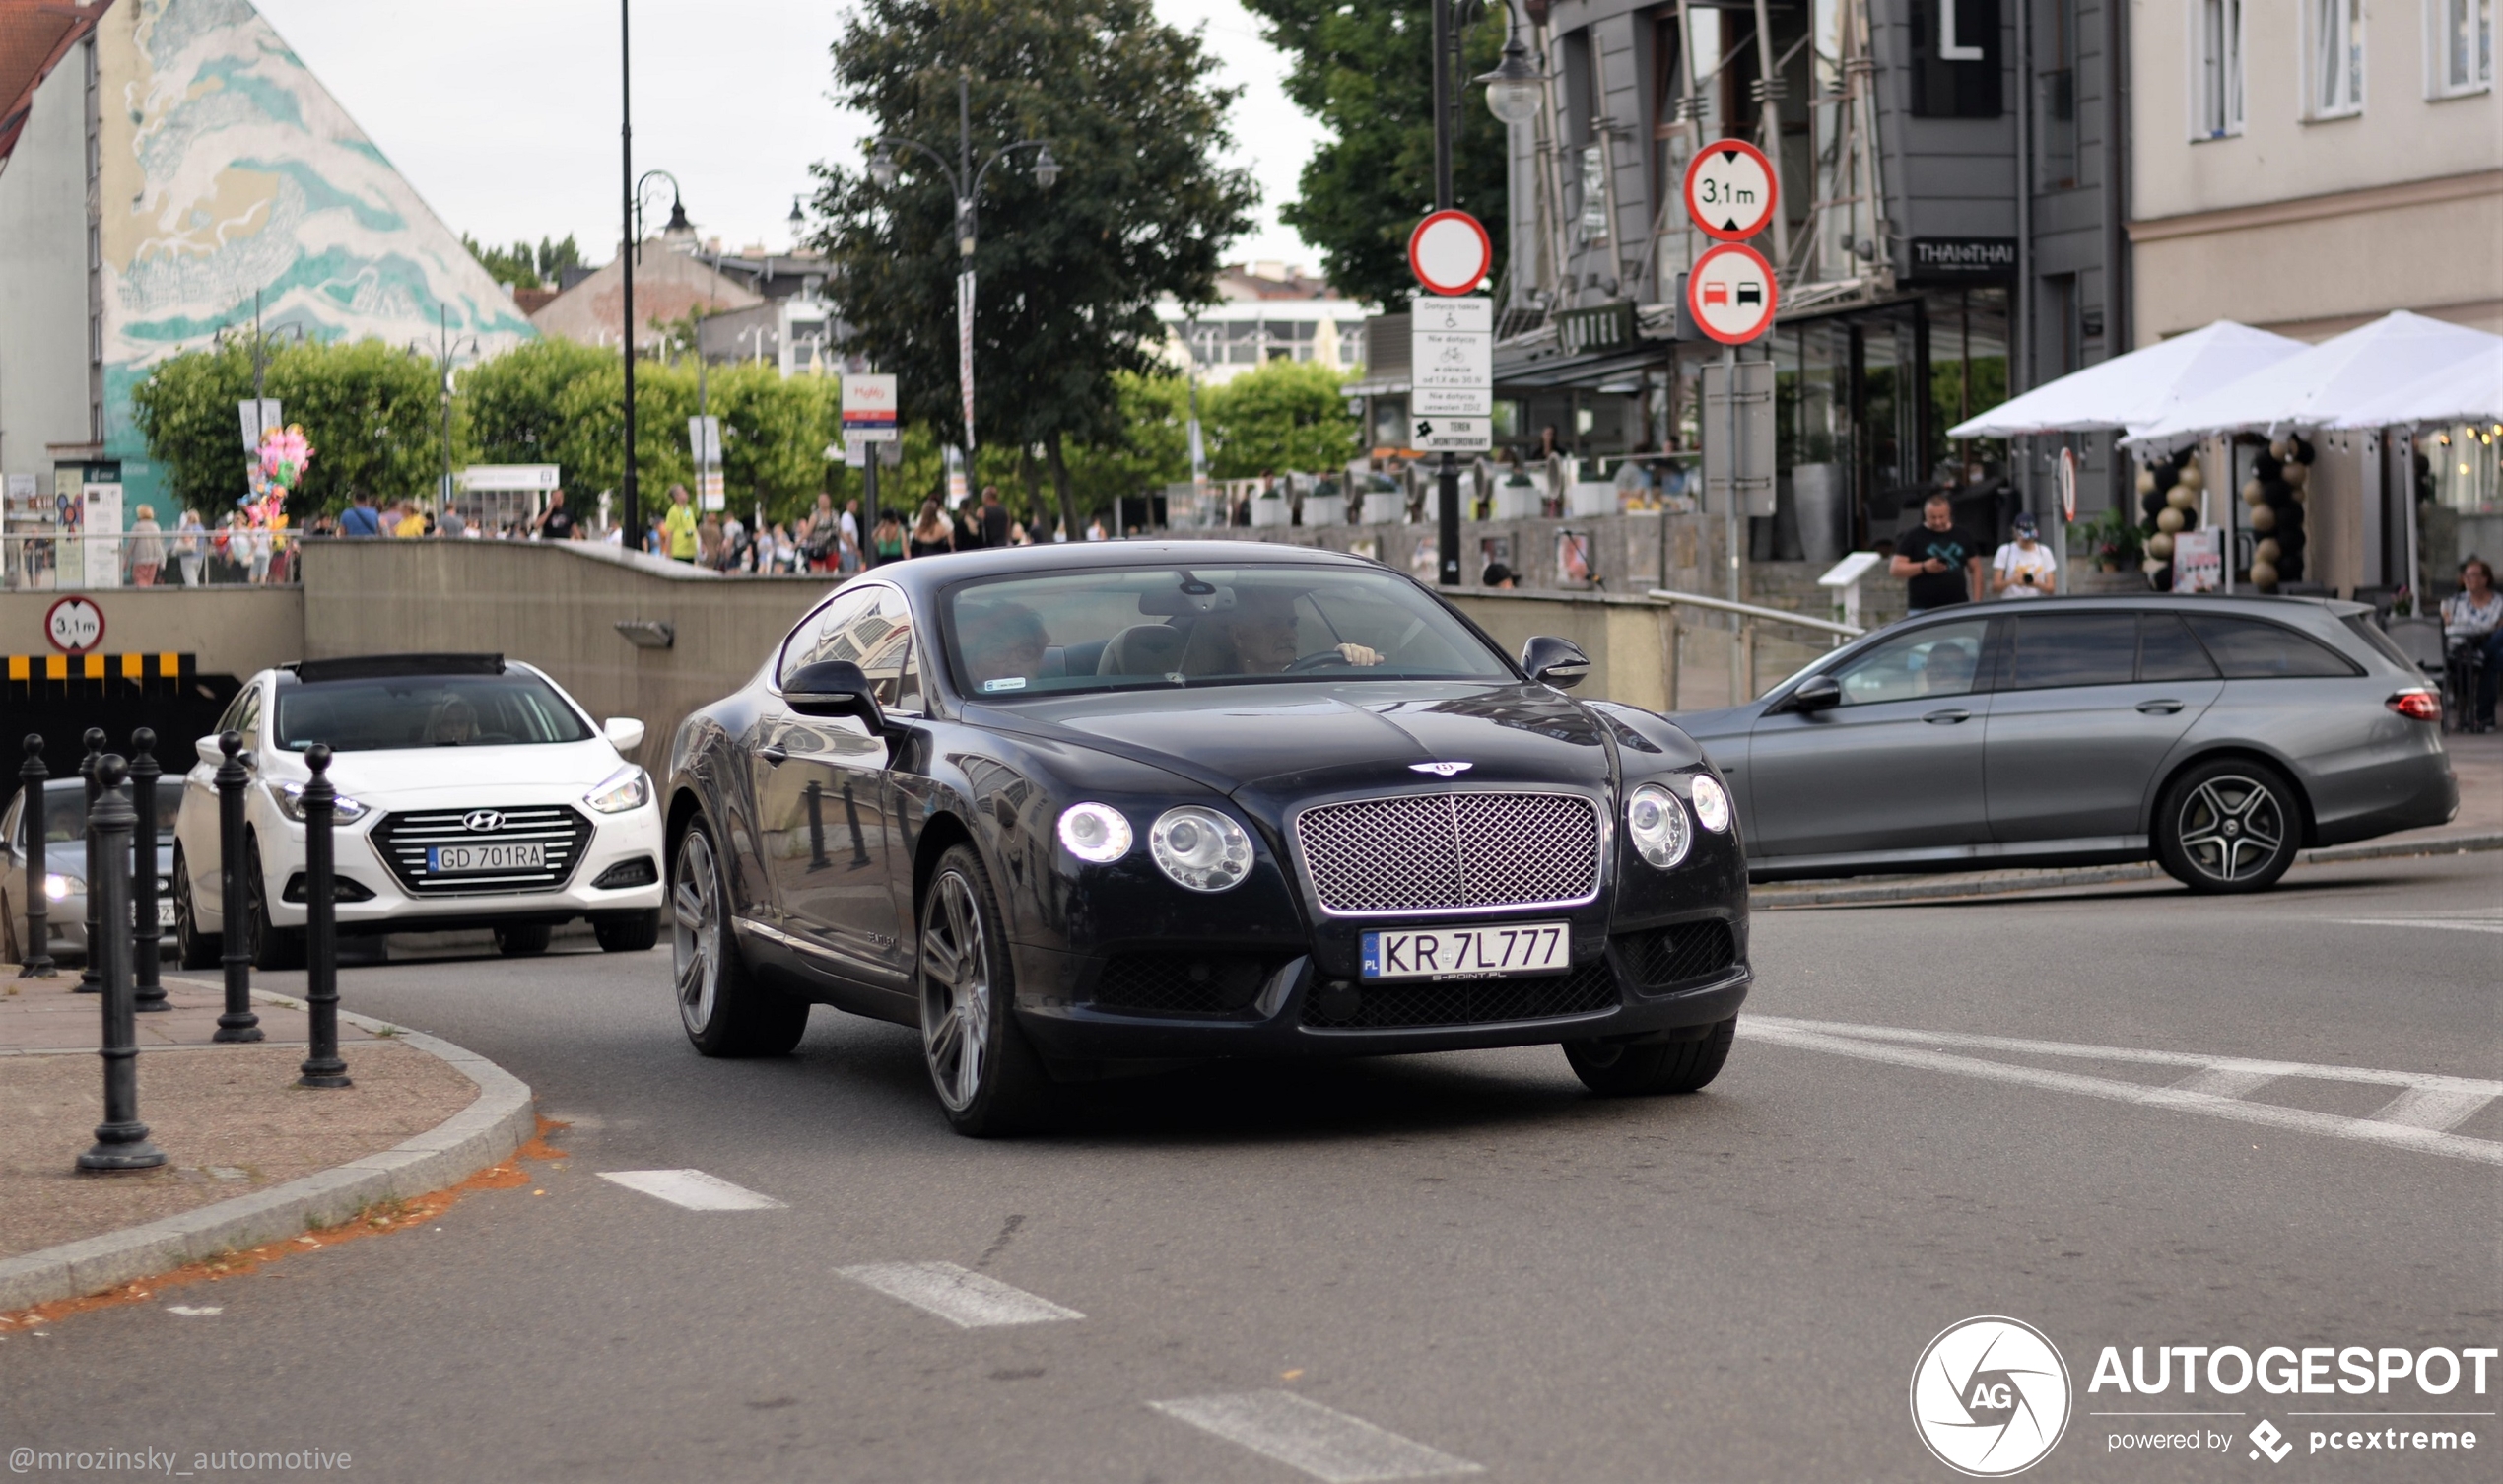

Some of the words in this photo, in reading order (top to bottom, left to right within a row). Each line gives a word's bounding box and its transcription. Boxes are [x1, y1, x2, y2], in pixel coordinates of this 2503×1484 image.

[1446, 336, 1476, 345] dotyczy
[1446, 393, 1476, 402] dotyczy
[1450, 422, 1471, 432] TEREN
[1433, 437, 1488, 447] MONITOROWANY
[441, 849, 470, 868] GD
[478, 846, 541, 868] 701RA
[1387, 935, 1439, 972] KR
[1454, 928, 1561, 970] 7L777
[1365, 959, 1378, 970] PL
